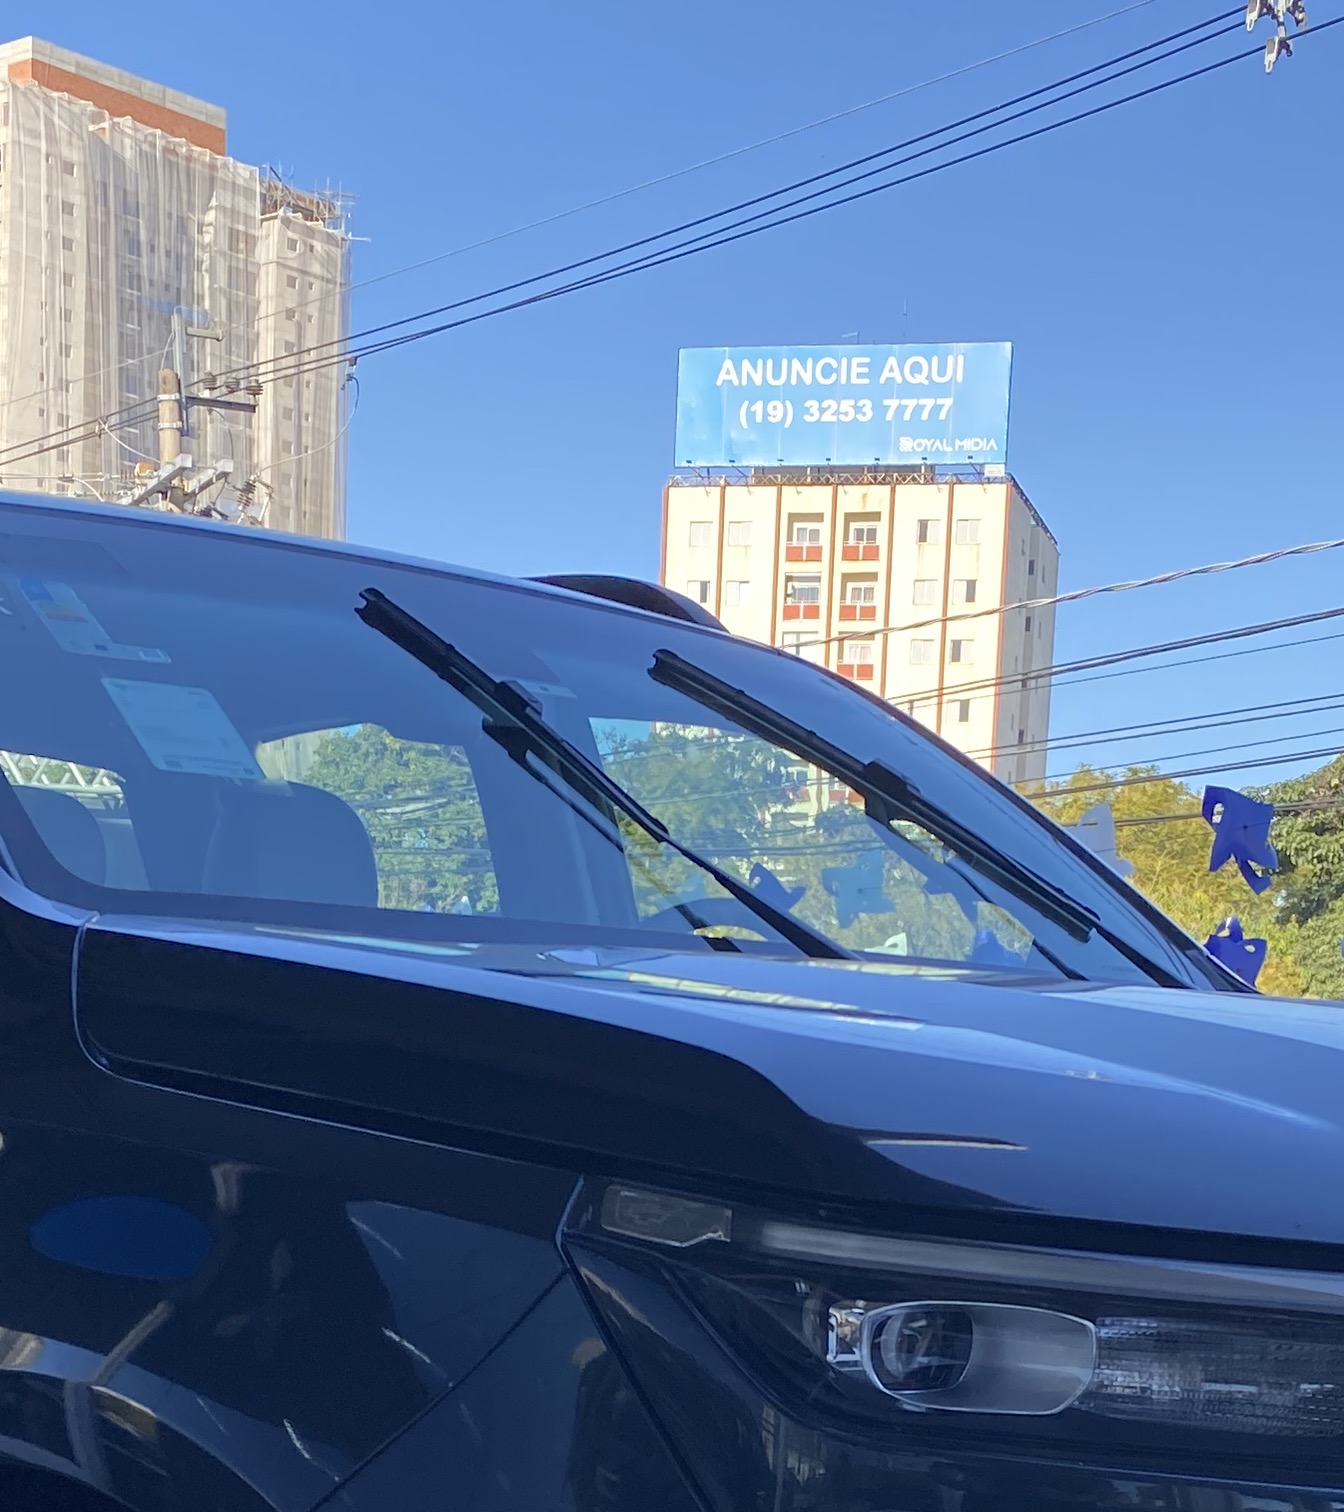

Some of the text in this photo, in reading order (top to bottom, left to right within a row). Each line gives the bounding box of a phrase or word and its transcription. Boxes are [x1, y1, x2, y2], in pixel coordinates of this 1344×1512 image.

[716, 354, 965, 387] ANUNCIE AQUI
[739, 397, 954, 429] (19) 3253 7777
[899, 436, 954, 453] ROYAL
